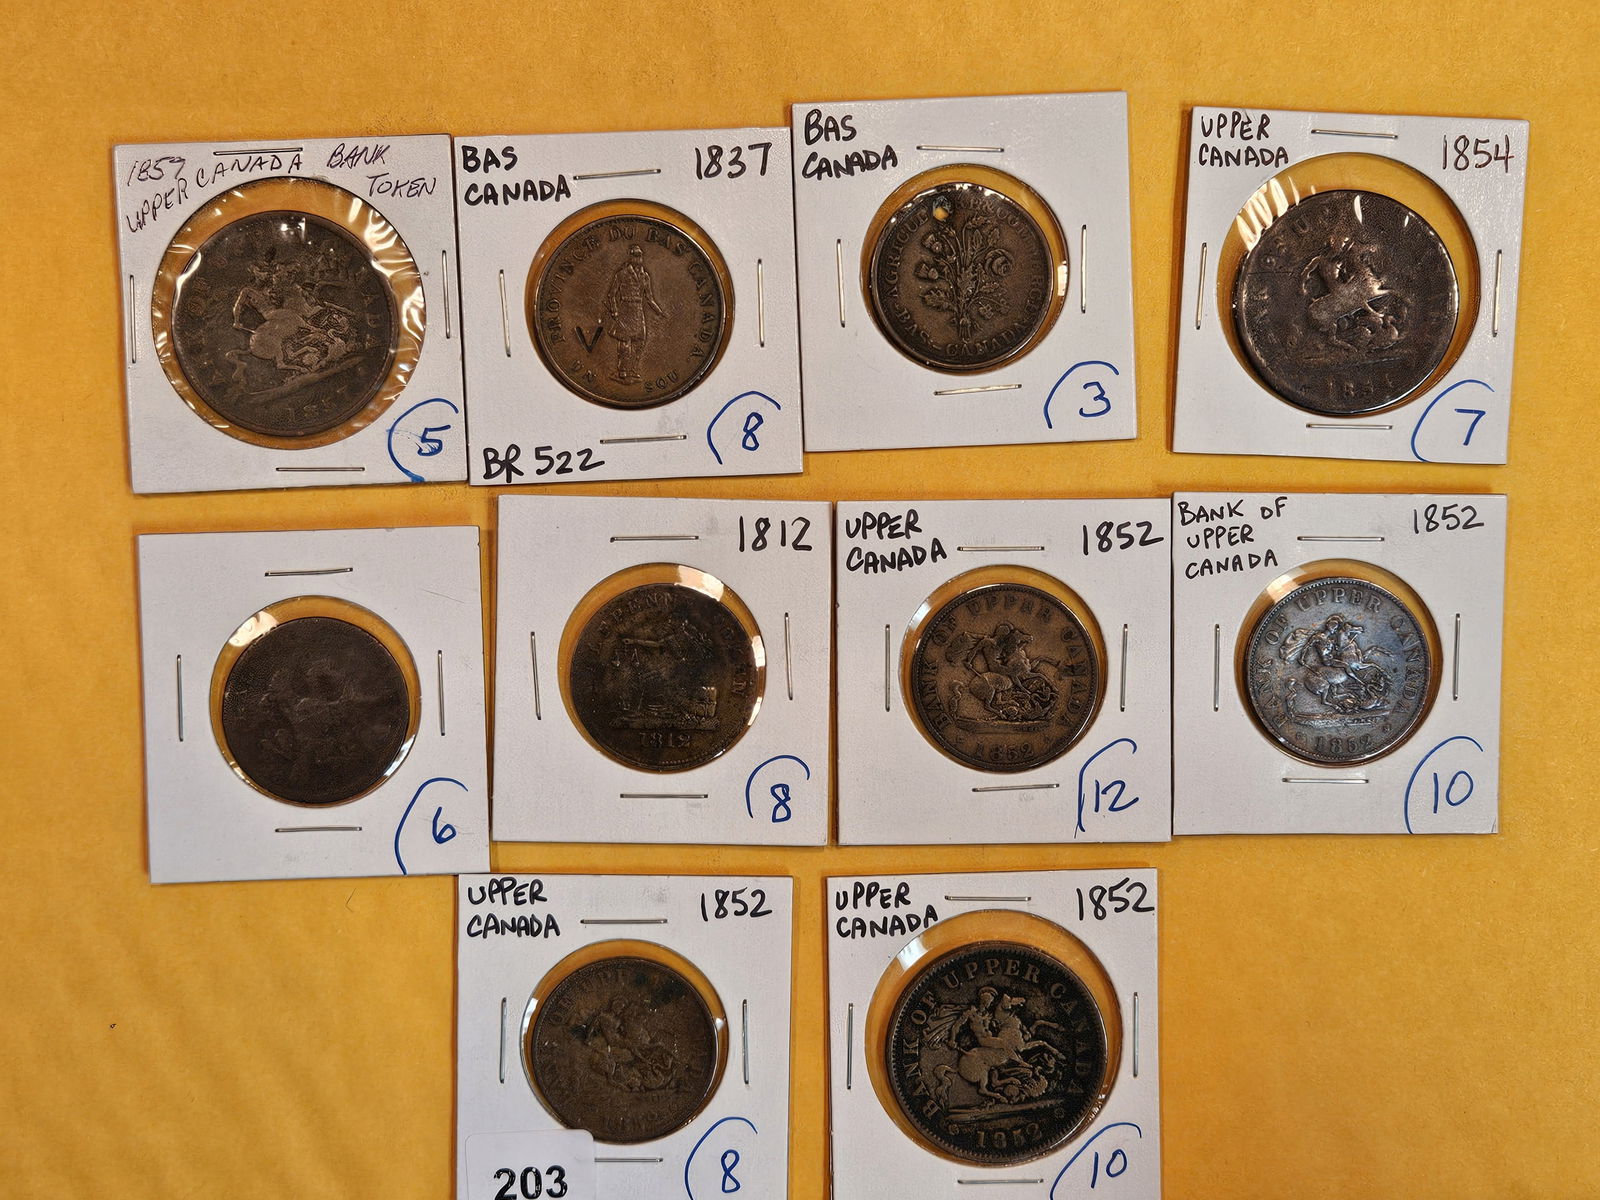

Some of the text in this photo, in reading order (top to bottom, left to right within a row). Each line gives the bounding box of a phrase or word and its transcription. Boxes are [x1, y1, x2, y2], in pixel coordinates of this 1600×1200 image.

[804, 109, 858, 146] BAS
[1200, 111, 1270, 140] UPPER
[461, 145, 518, 173] BAS
[694, 142, 772, 180] 1837
[801, 144, 899, 180] CANADA
[1198, 146, 1289, 168] CANADA
[1442, 134, 1516, 173] 1854
[126, 143, 391, 233] UPPER CANADA BANK
[366, 174, 437, 198] TOKEN
[464, 174, 572, 206] CANADA
[546, 225, 715, 360] PROVINCE DU BAS CANADA
[643, 369, 680, 393] SOU
[1078, 381, 1112, 418] 3
[417, 424, 452, 457] 5
[741, 411, 764, 451] 8
[1454, 407, 1486, 446] 7
[482, 444, 606, 483] BR 522
[845, 509, 922, 540] UPPER
[1178, 496, 1287, 526] BANK OF
[1412, 504, 1485, 535] 1852
[739, 516, 813, 552] 1812
[1082, 521, 1165, 556] 1852
[1186, 524, 1255, 549] UPPER
[846, 538, 947, 574] CANADA
[1185, 549, 1279, 579] CANADA
[965, 594, 1052, 623] UPPER
[1263, 615, 1290, 647] OF
[1296, 586, 1382, 614] UPPER
[769, 783, 793, 824] 8
[1094, 779, 1140, 813] 12
[1432, 770, 1475, 815] 10
[432, 806, 457, 845] 6
[467, 876, 548, 906] UPPER
[700, 886, 773, 922] 1852
[835, 881, 912, 910] UPPER
[1075, 877, 1155, 921] 1852
[466, 913, 561, 939] CANADA
[835, 904, 938, 939] CANADA
[944, 957, 1042, 989] UPPER
[909, 988, 938, 1025] OF
[903, 1037, 944, 1119] BANK
[493, 1164, 569, 1200] 203
[720, 1149, 742, 1194] 8
[1090, 1149, 1128, 1189] 10
